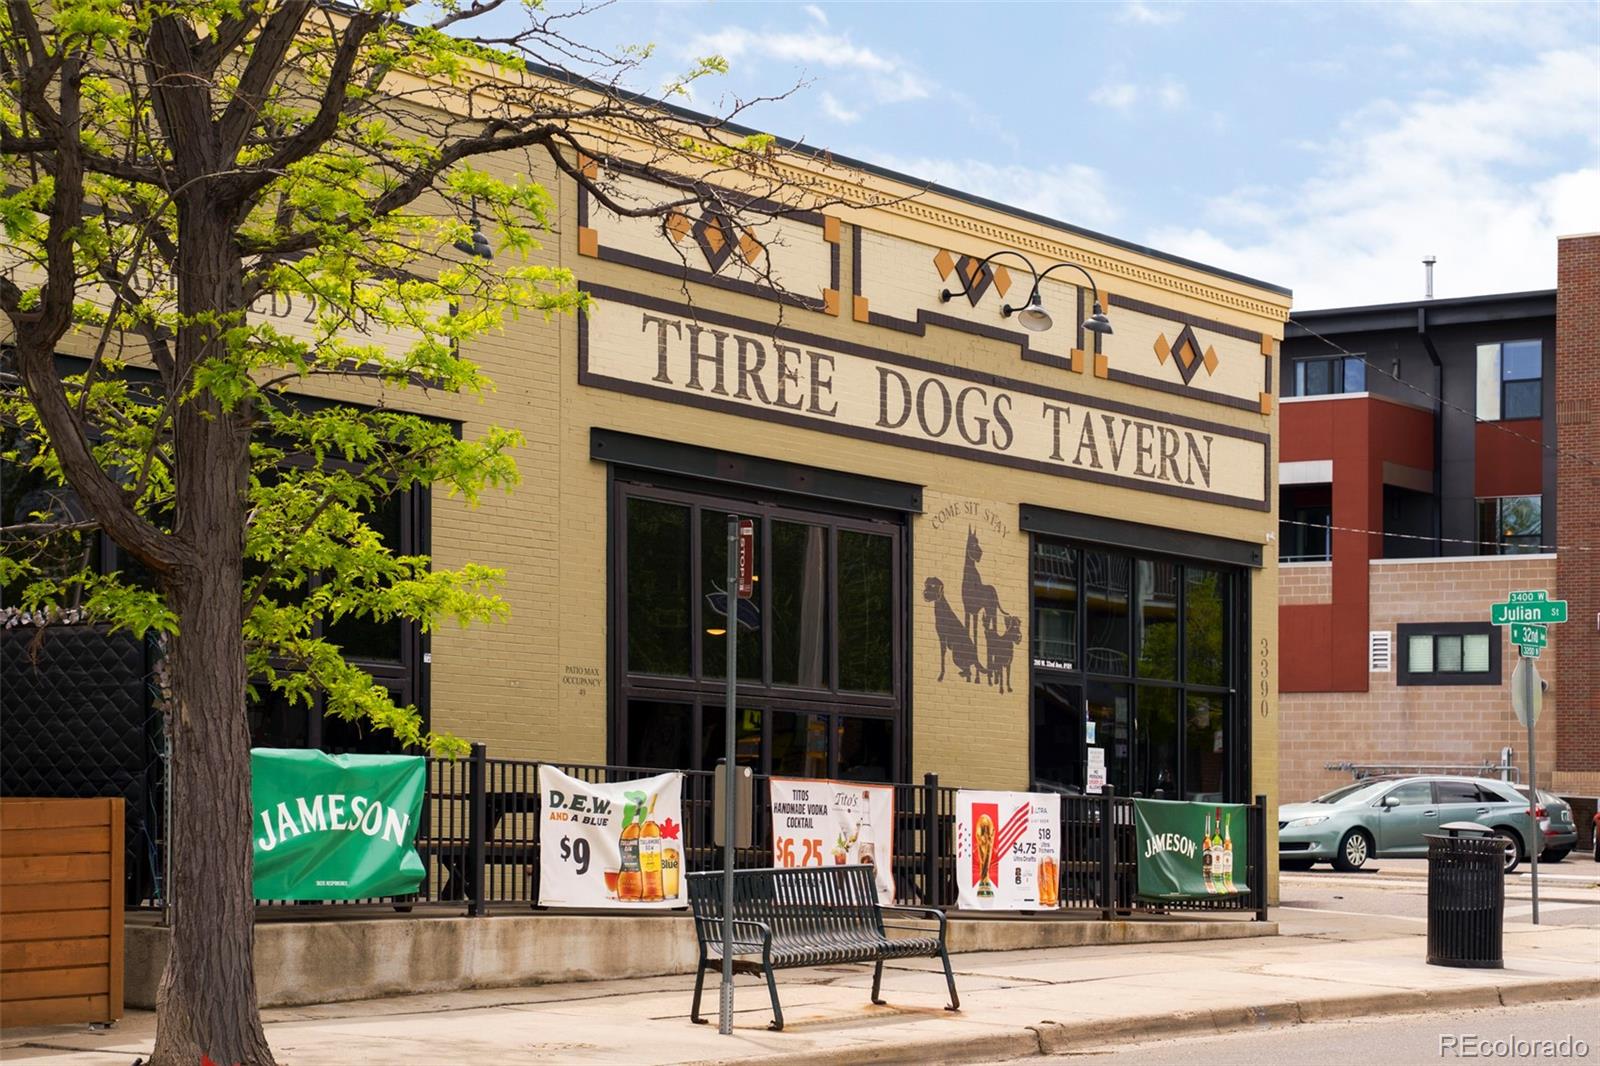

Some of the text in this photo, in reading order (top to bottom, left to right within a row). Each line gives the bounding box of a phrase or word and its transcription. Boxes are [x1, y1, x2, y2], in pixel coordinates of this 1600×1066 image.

[642, 313, 1214, 488] THREE DOGS TAVERN
[931, 501, 1010, 538] COME SIT STAY
[1511, 592, 1544, 602] 3400 W
[1498, 605, 1560, 621] Julian St
[1522, 626, 1539, 643] 32nd
[565, 665, 600, 676] PATIO MAX
[1260, 637, 1269, 718] 3390
[562, 675, 601, 687] OCCUPANCY
[549, 790, 612, 815] D.E.W.
[792, 789, 809, 801] TITOS
[834, 792, 858, 807] Tito's
[773, 803, 828, 816] HANDMADE VODKA
[258, 794, 410, 851] JAMESON
[549, 812, 609, 827] AND A BLUE
[786, 816, 814, 828] COCKTAIL
[1038, 828, 1051, 840] $18
[1013, 843, 1037, 854] $4.75
[1144, 833, 1196, 859] JAMESON
[560, 835, 591, 875] $9
[661, 858, 679, 869] Blue
